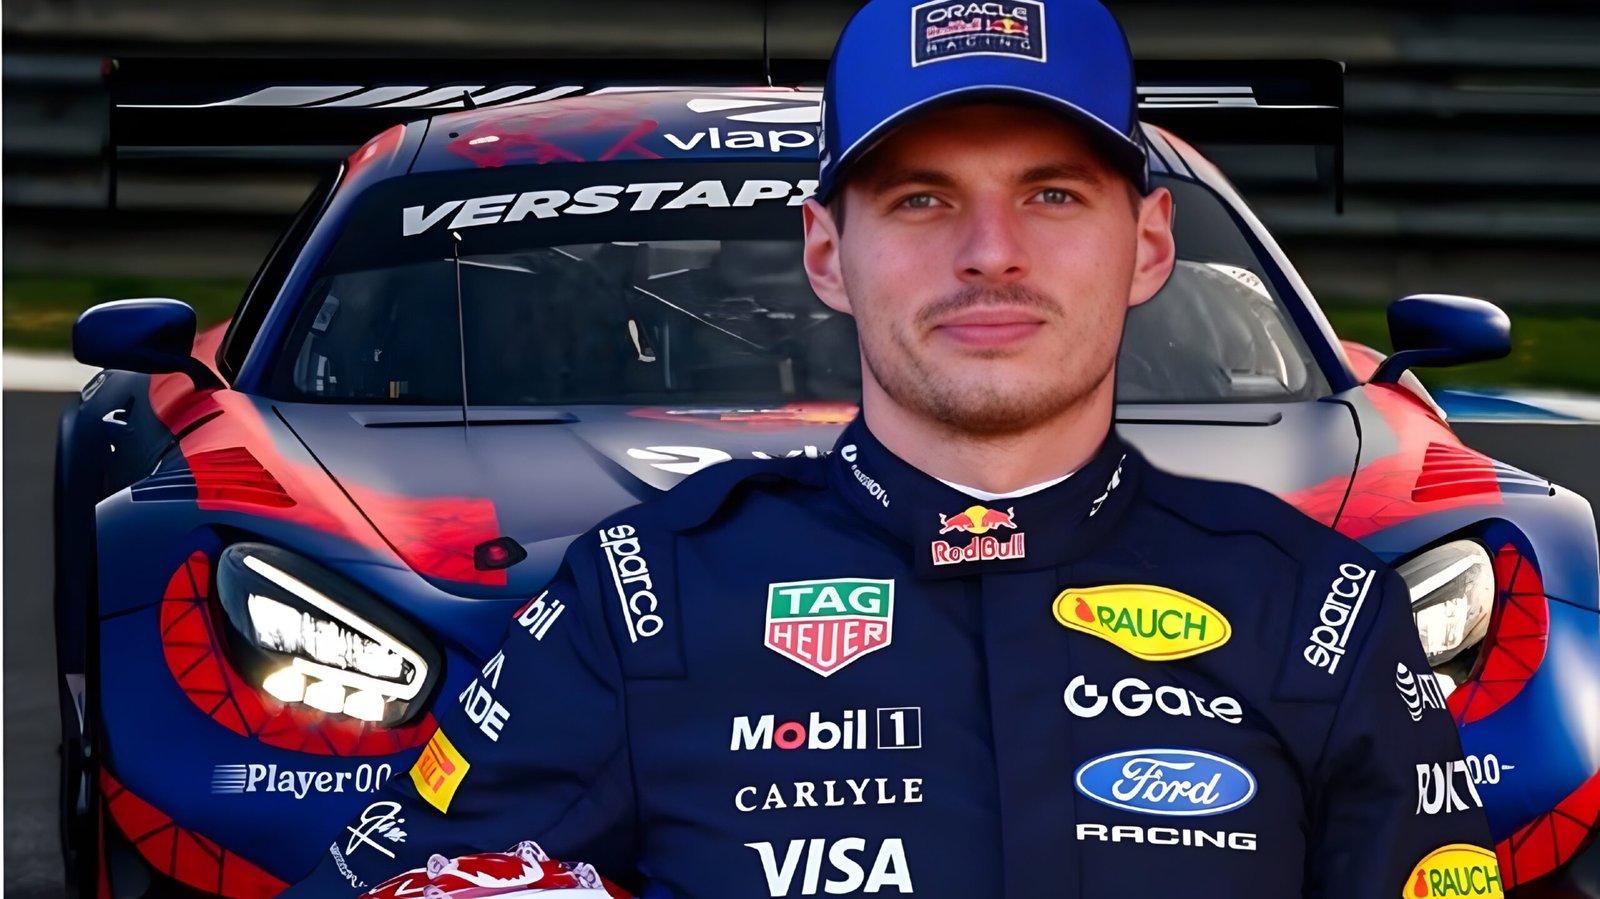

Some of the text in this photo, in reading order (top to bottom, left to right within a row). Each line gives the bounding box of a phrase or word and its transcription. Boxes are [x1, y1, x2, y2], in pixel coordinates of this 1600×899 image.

[926, 2, 1028, 23] ORACLE
[600, 524, 664, 638] sparco
[778, 586, 881, 615] TAG
[1097, 605, 1207, 641] RAUCH
[1303, 563, 1367, 668] sparco
[773, 621, 884, 668] HEUER
[1111, 677, 1244, 725] Gate
[730, 708, 868, 751] Mobil
[245, 763, 352, 800] Player
[734, 777, 924, 813] CARLYLE
[1111, 757, 1223, 805] Ford
[1075, 823, 1258, 851] RACING
[743, 837, 914, 898] VISA
[1428, 865, 1504, 898] RAUCH
